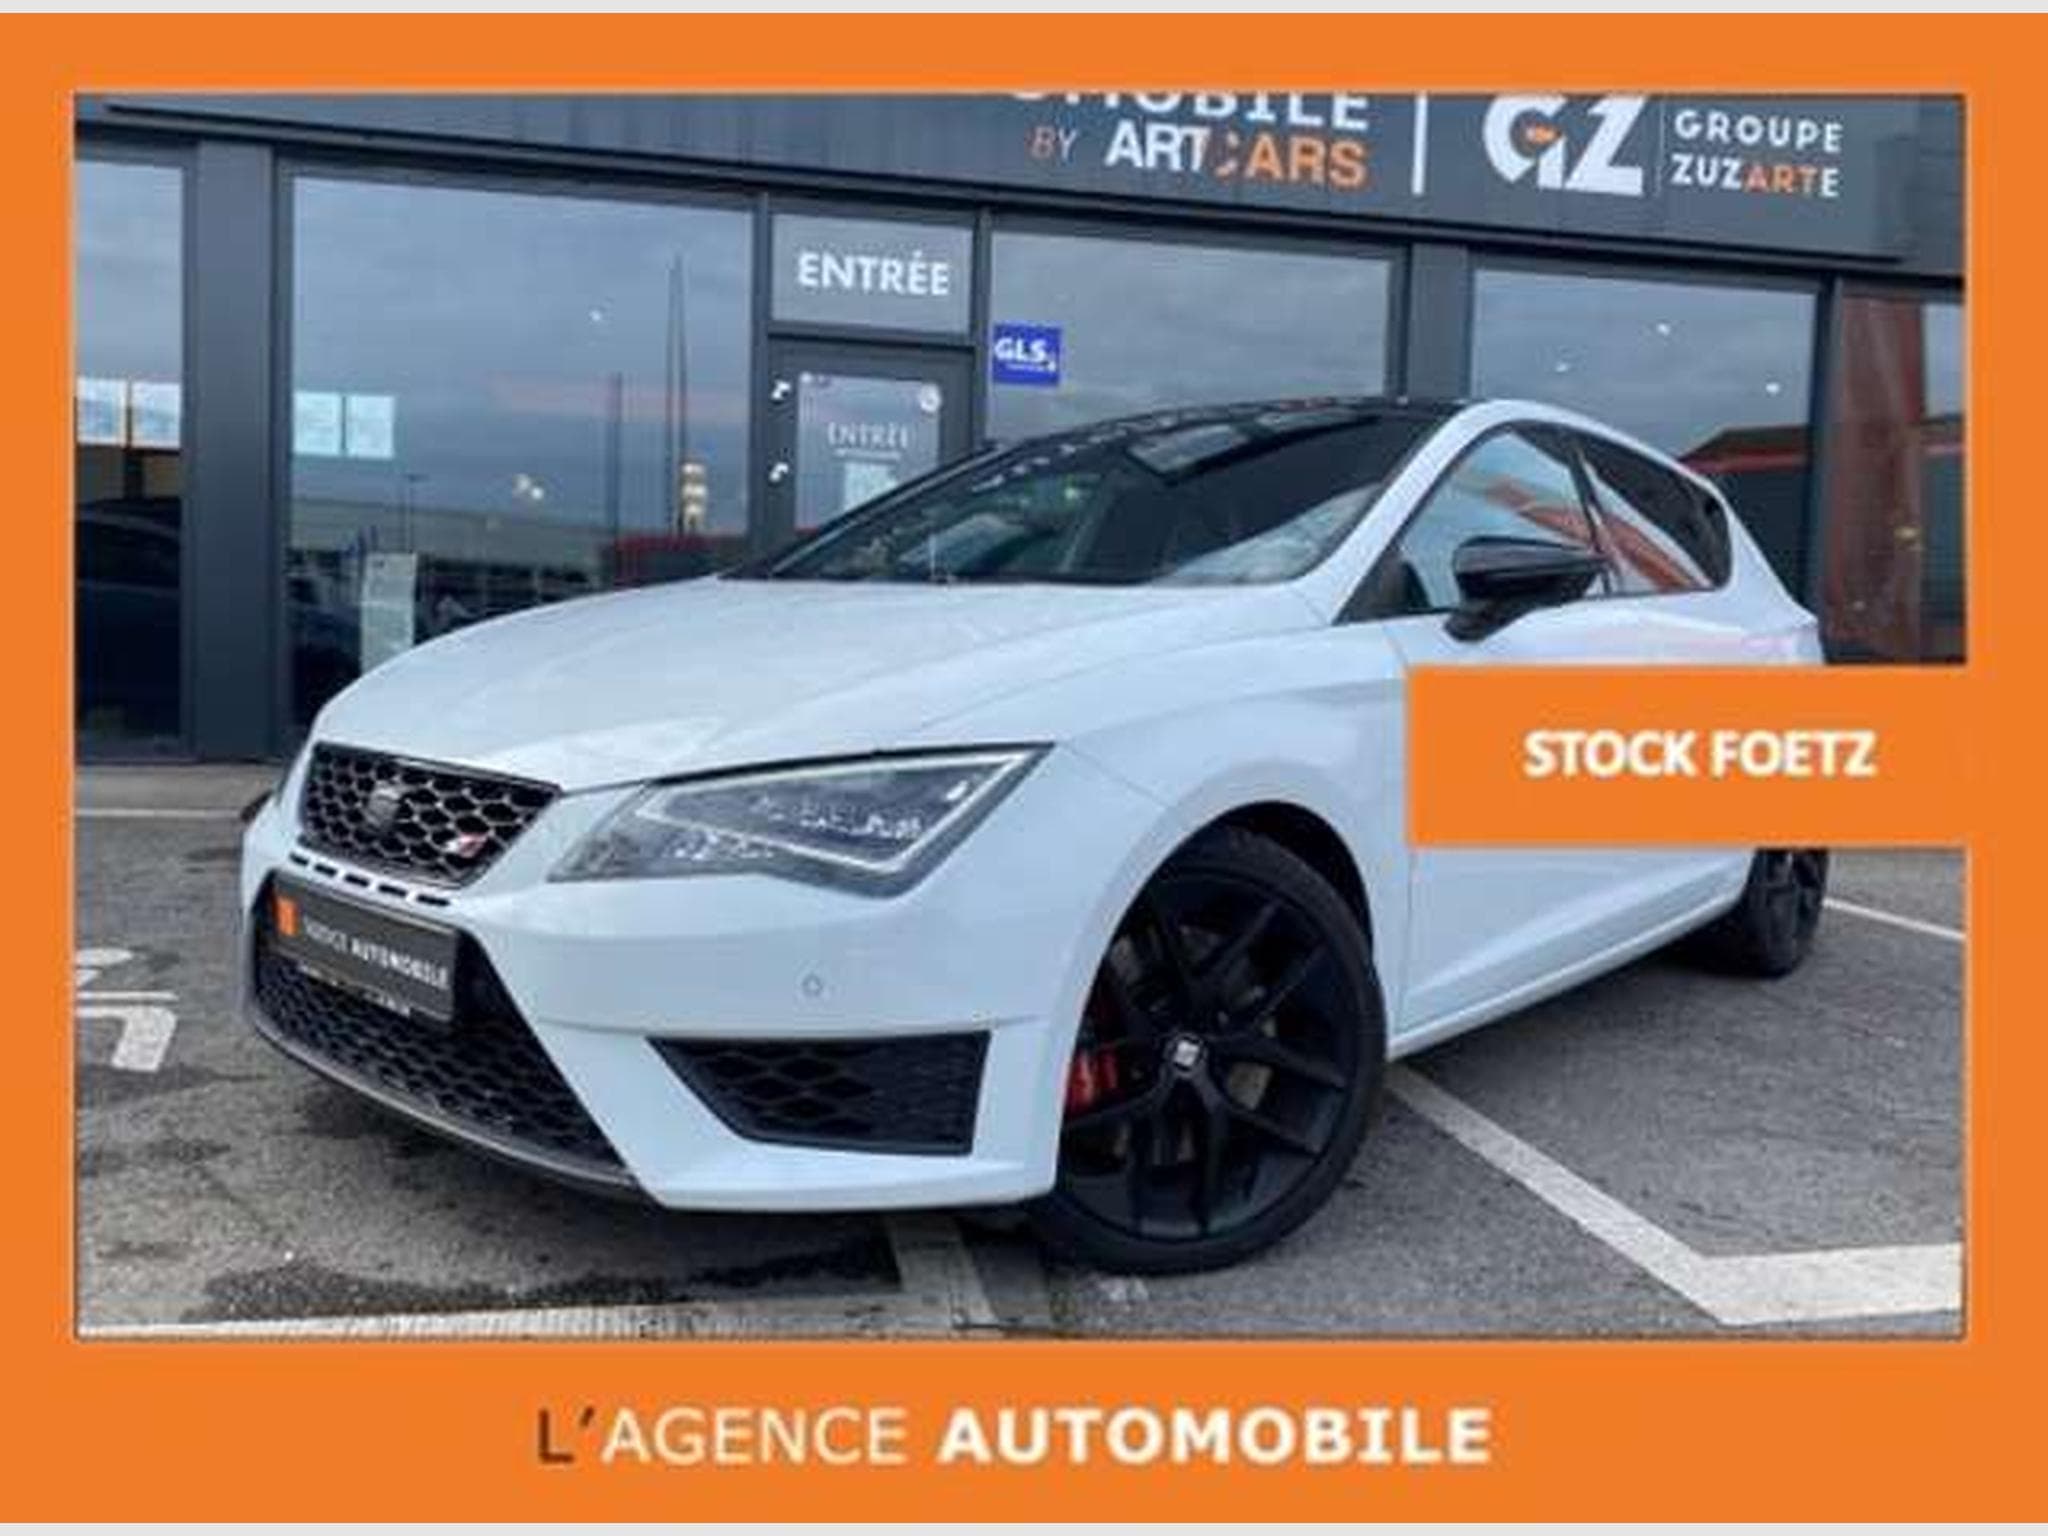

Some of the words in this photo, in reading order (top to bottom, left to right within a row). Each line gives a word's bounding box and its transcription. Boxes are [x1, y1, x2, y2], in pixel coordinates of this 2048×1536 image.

[1031, 126, 1076, 159] BY
[1674, 109, 1843, 152] GROUPE
[1669, 153, 1840, 198] ZUZARTE
[798, 250, 950, 296] ENTRÉE
